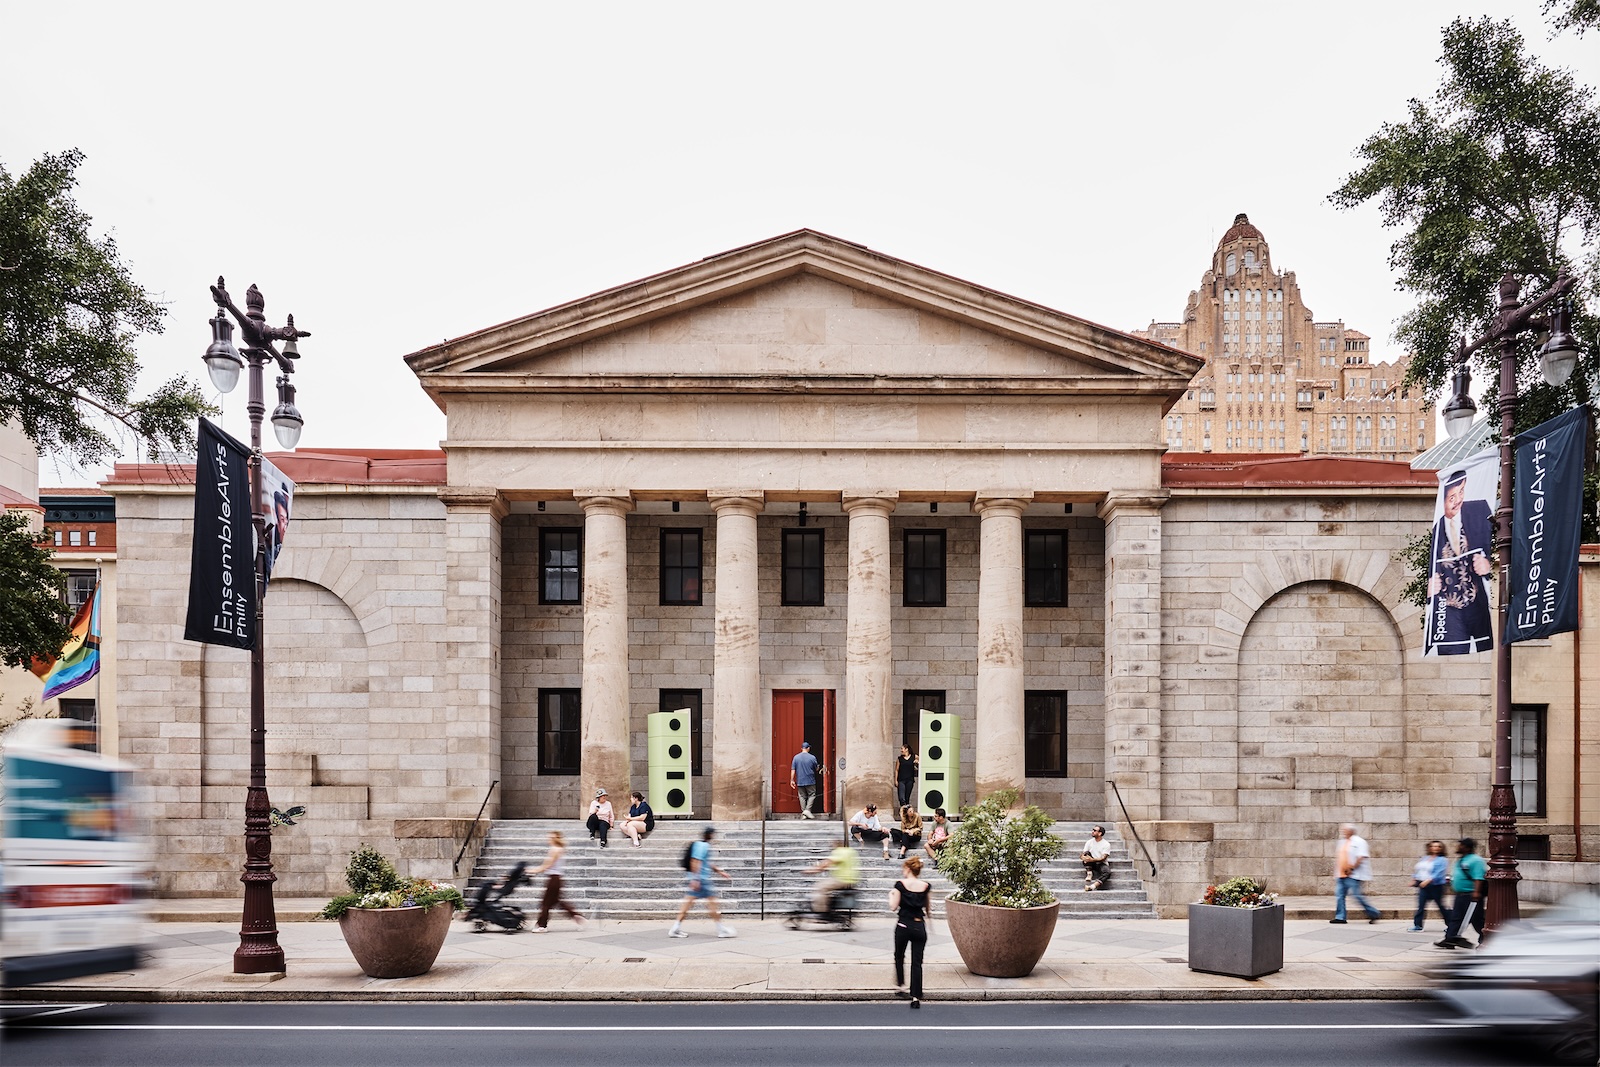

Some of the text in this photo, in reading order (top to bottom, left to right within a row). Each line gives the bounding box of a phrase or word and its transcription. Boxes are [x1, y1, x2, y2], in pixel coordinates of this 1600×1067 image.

[213, 442, 233, 634] EnsembleArts
[1518, 437, 1547, 629] EnsembleArts
[236, 593, 248, 638] Philly
[1433, 597, 1448, 641] Speaker
[1541, 578, 1558, 625] Philly
